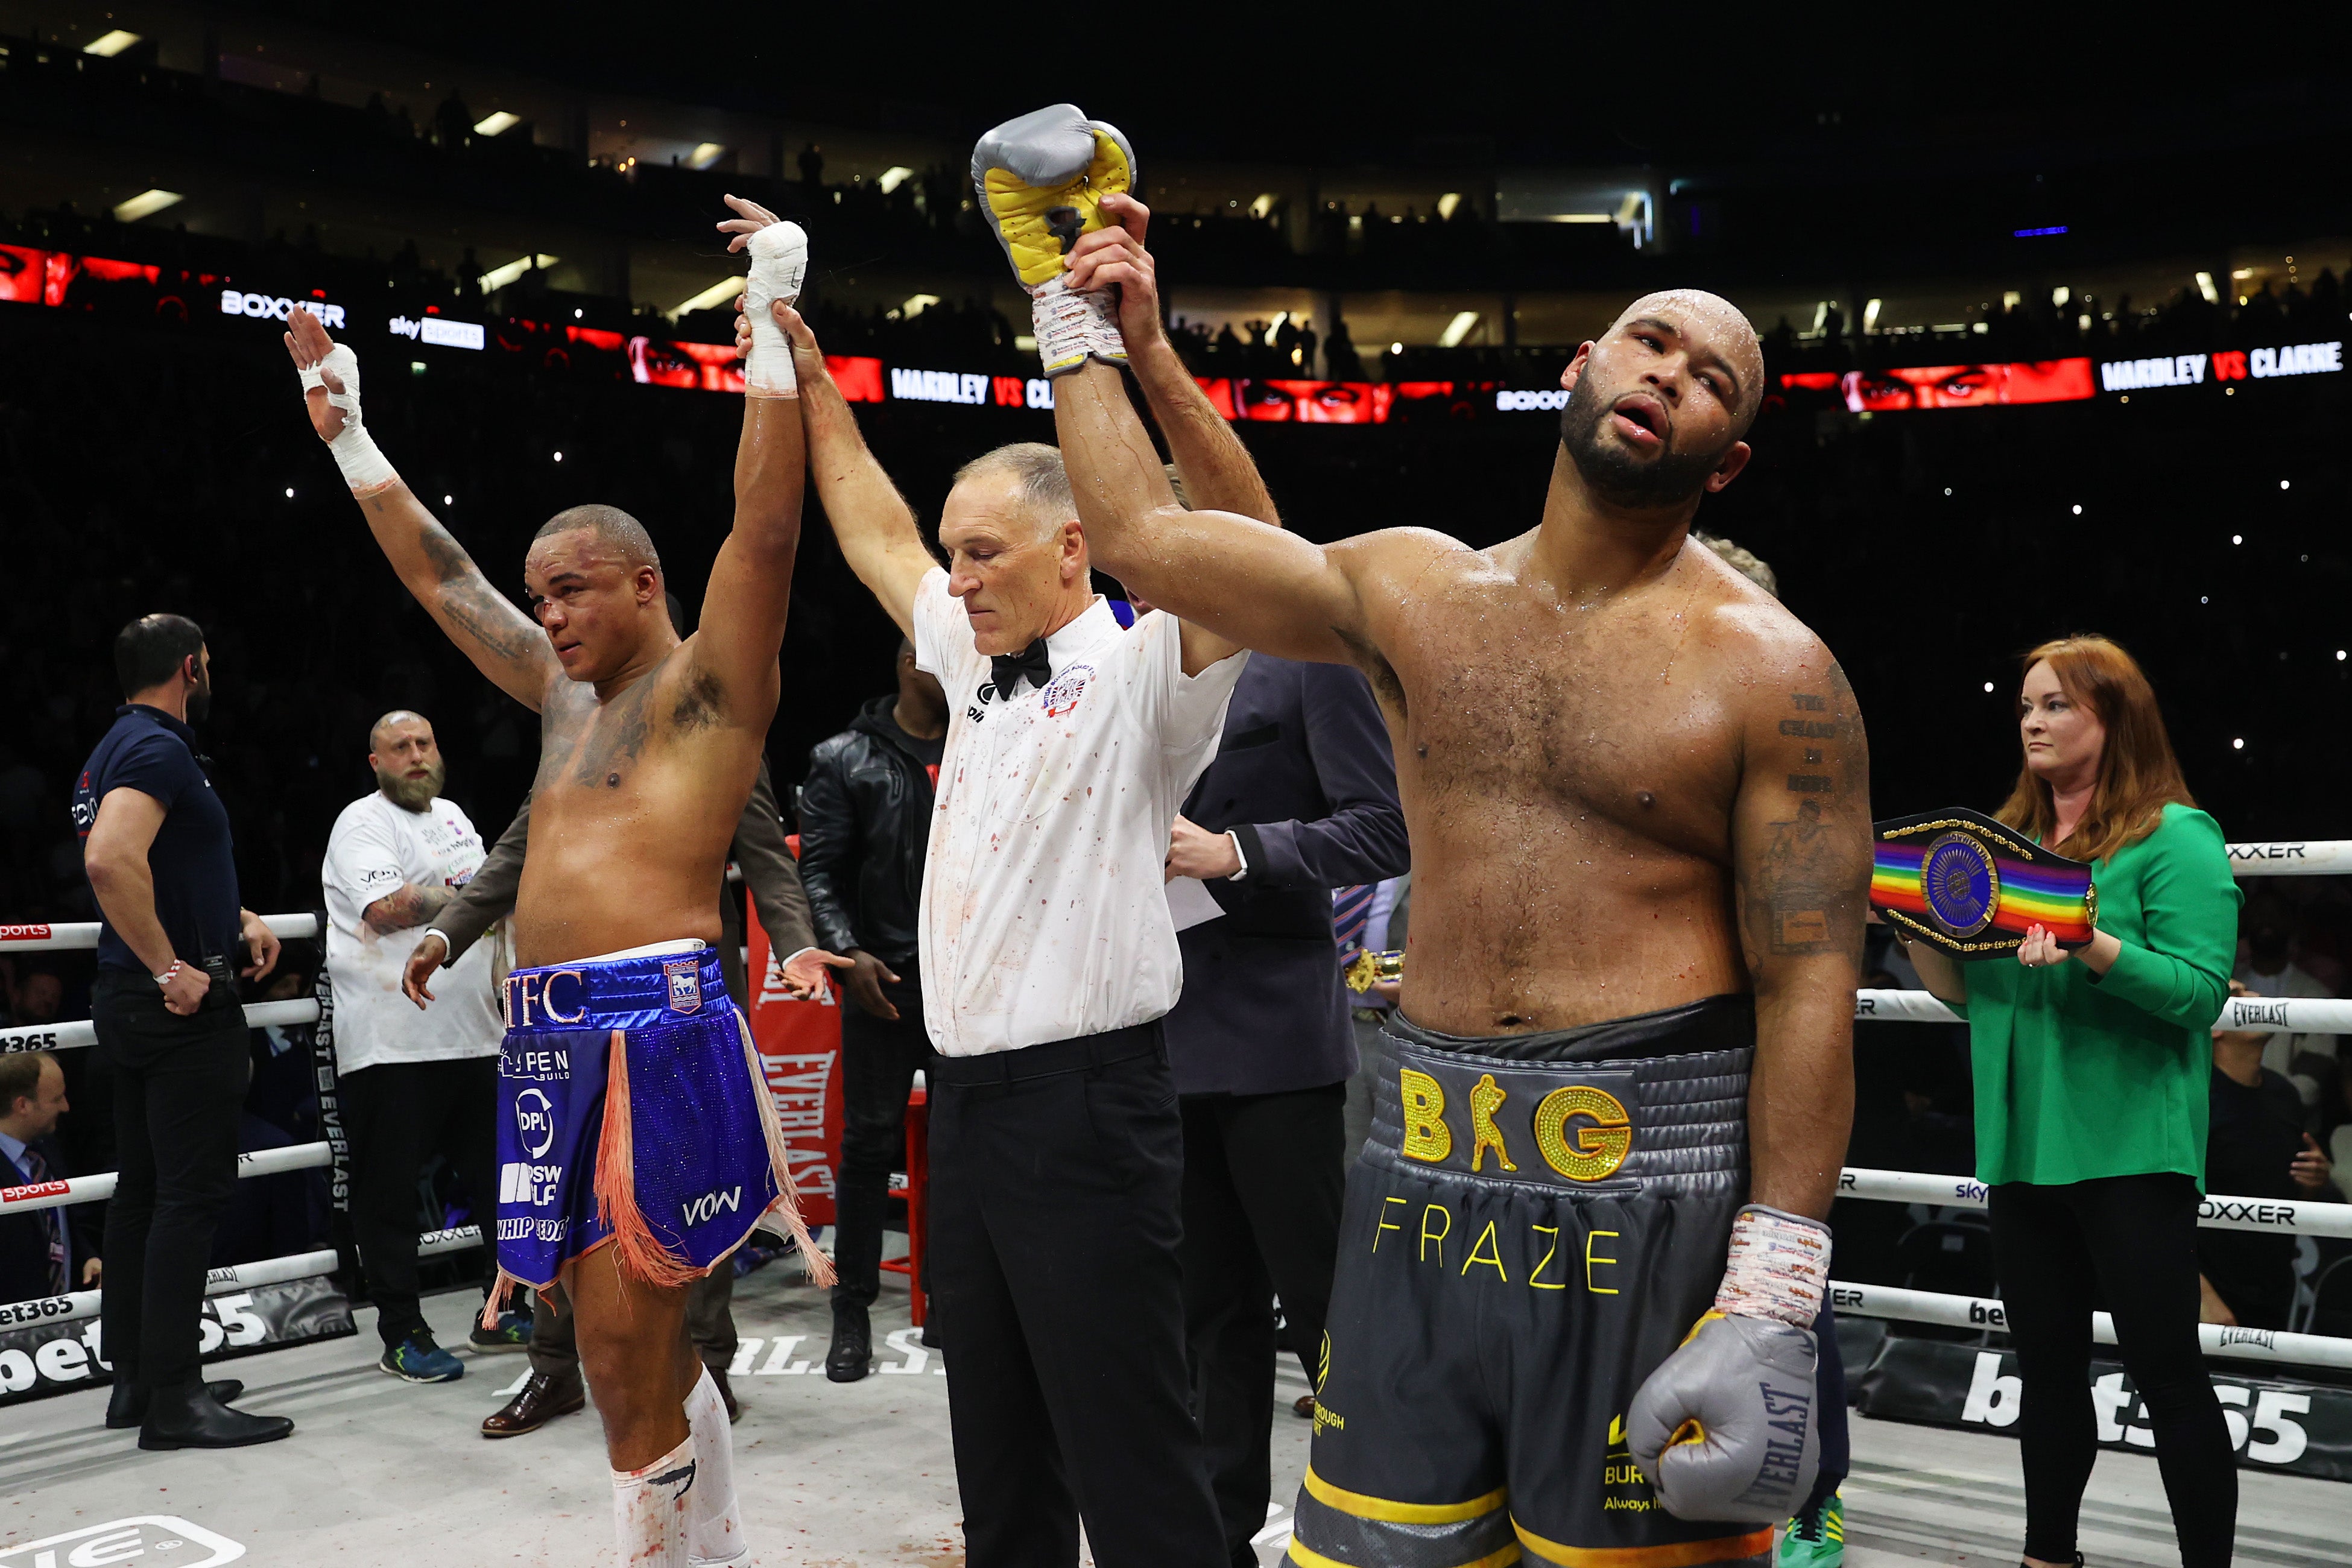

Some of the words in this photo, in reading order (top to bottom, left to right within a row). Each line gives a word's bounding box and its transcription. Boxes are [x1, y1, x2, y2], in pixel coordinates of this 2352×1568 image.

[389, 315, 420, 340] sky
[2212, 350, 2248, 382] VS
[2250, 341, 2344, 379] CLARKE
[992, 376, 1024, 408] VS
[2234, 1001, 2290, 1028] EVERLAST
[520, 1112, 547, 1131] DPL
[762, 1049, 838, 1200] EVERLAST
[321, 1095, 350, 1212] EVERLAST
[4, 1179, 66, 1198] sports
[1956, 1183, 1989, 1203] sky
[682, 1186, 742, 1227] VOW
[1372, 1197, 1620, 1295] FRAZE
[2220, 1326, 2277, 1351] EVERLAST
[1730, 1380, 1810, 1512] EVERLAST
[1604, 1496, 1651, 1513] Always
